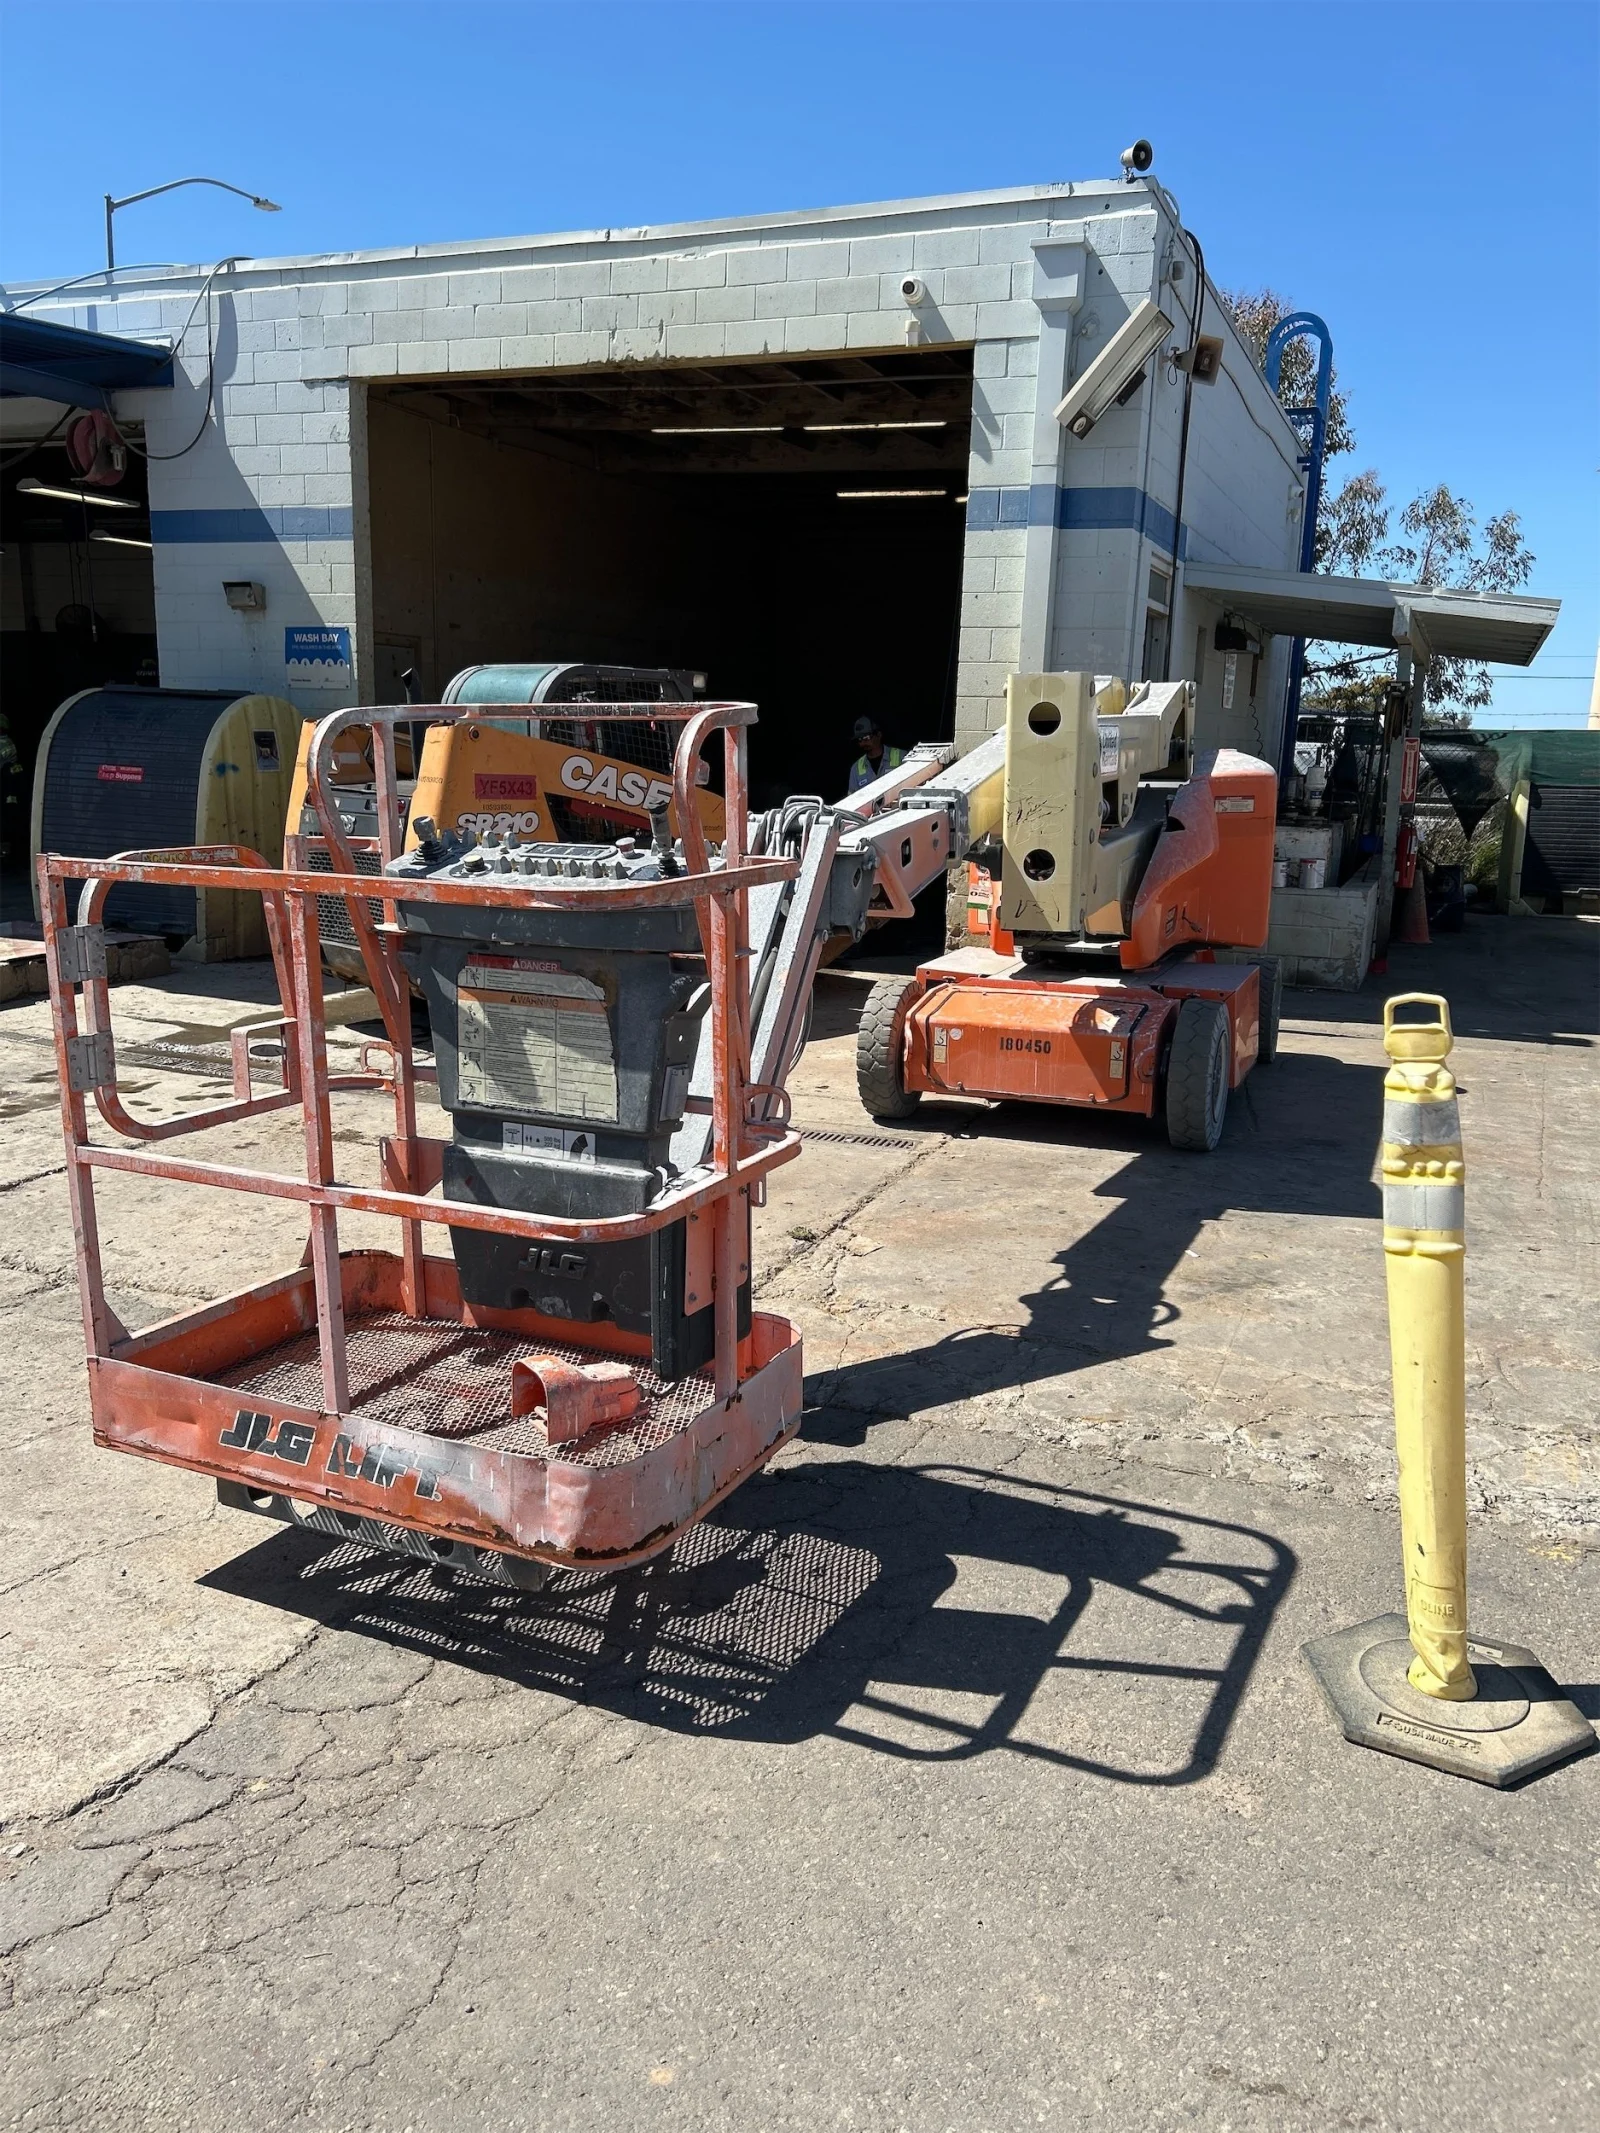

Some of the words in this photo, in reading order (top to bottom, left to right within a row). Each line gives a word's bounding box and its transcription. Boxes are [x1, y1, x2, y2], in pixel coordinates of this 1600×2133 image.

[294, 633, 319, 643] WASH
[321, 633, 339, 643] BAY
[456, 811, 540, 836] SR210
[520, 958, 558, 973] DANGER
[517, 995, 560, 1008] WARNING
[1000, 1036, 1051, 1054] 180450
[519, 1247, 588, 1280] JLG
[218, 1409, 317, 1467] JLG
[325, 1432, 456, 1500] LIFT
[1425, 1733, 1456, 1748] MADE
